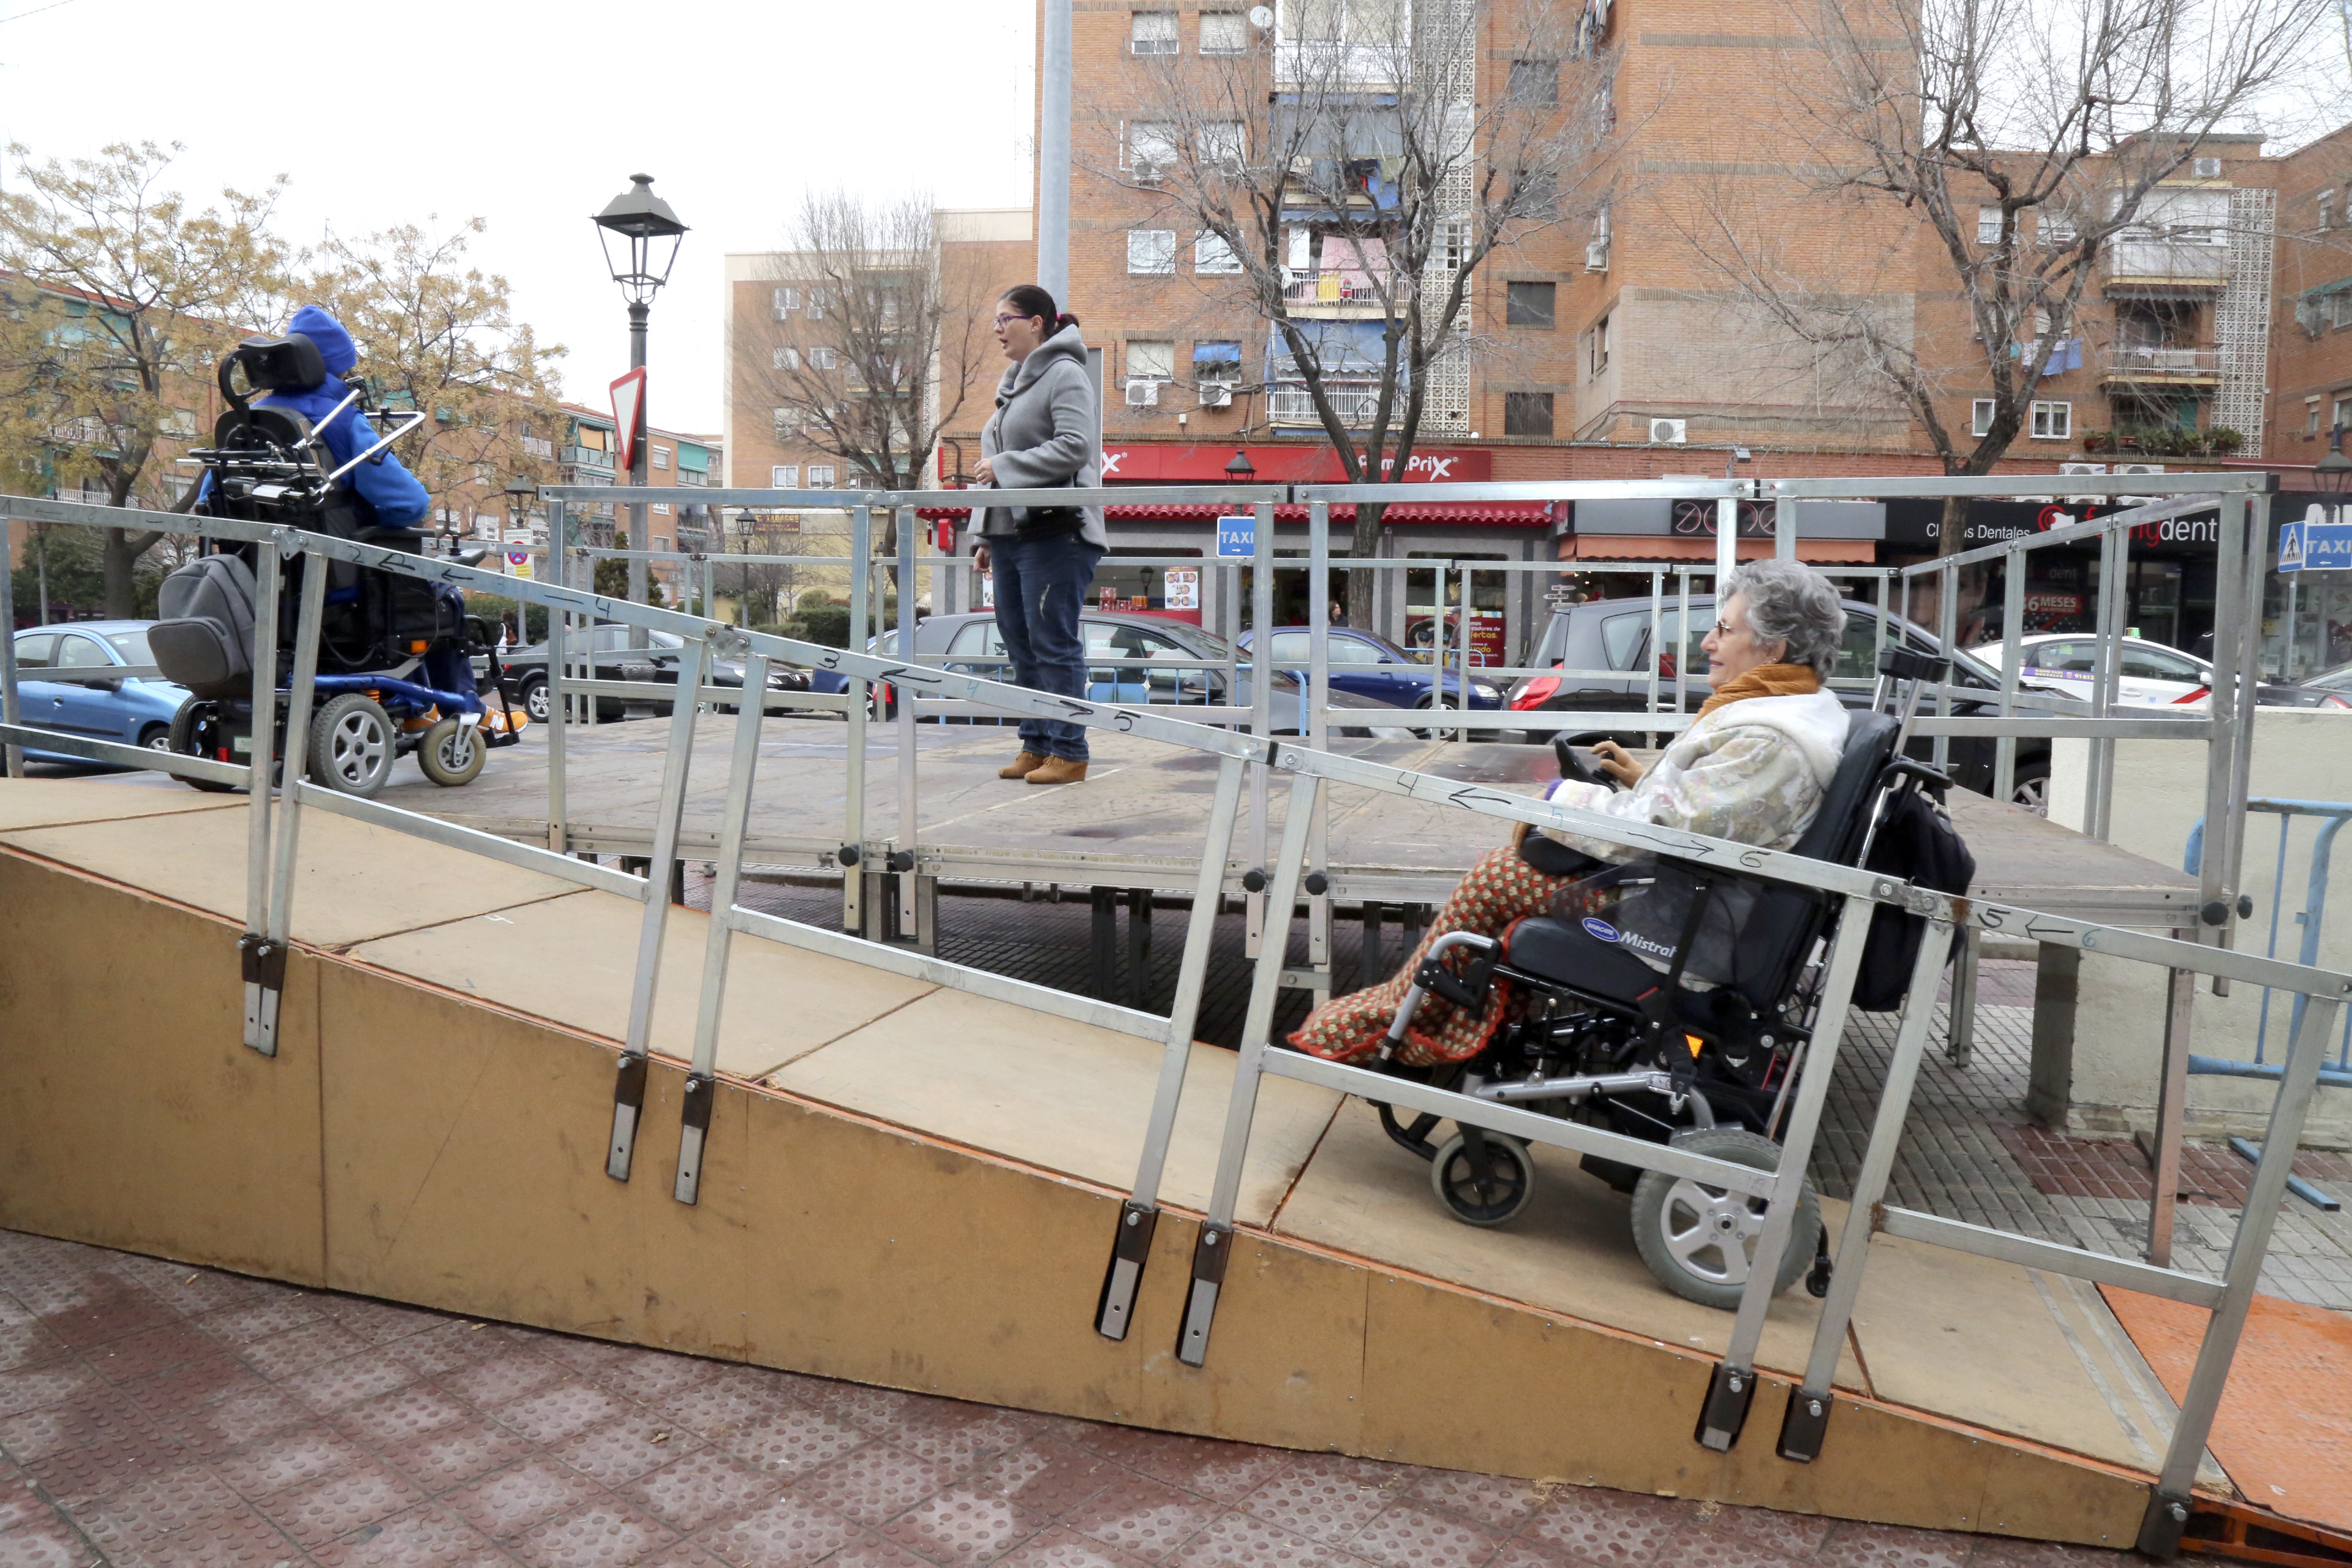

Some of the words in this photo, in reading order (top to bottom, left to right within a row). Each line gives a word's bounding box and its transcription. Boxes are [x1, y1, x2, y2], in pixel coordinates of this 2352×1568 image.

[1220, 532, 1254, 544] TAXI
[1978, 525, 2030, 539] Dentales
[2307, 540, 2352, 554] TAXI
[595, 597, 611, 619] 4
[2040, 597, 2076, 608] MESES
[816, 649, 840, 669] 3
[1114, 710, 1141, 731] 5
[1397, 772, 1419, 797] 4
[1740, 851, 1771, 867] 6
[1977, 908, 2011, 929] 5
[2082, 929, 2101, 947] 6
